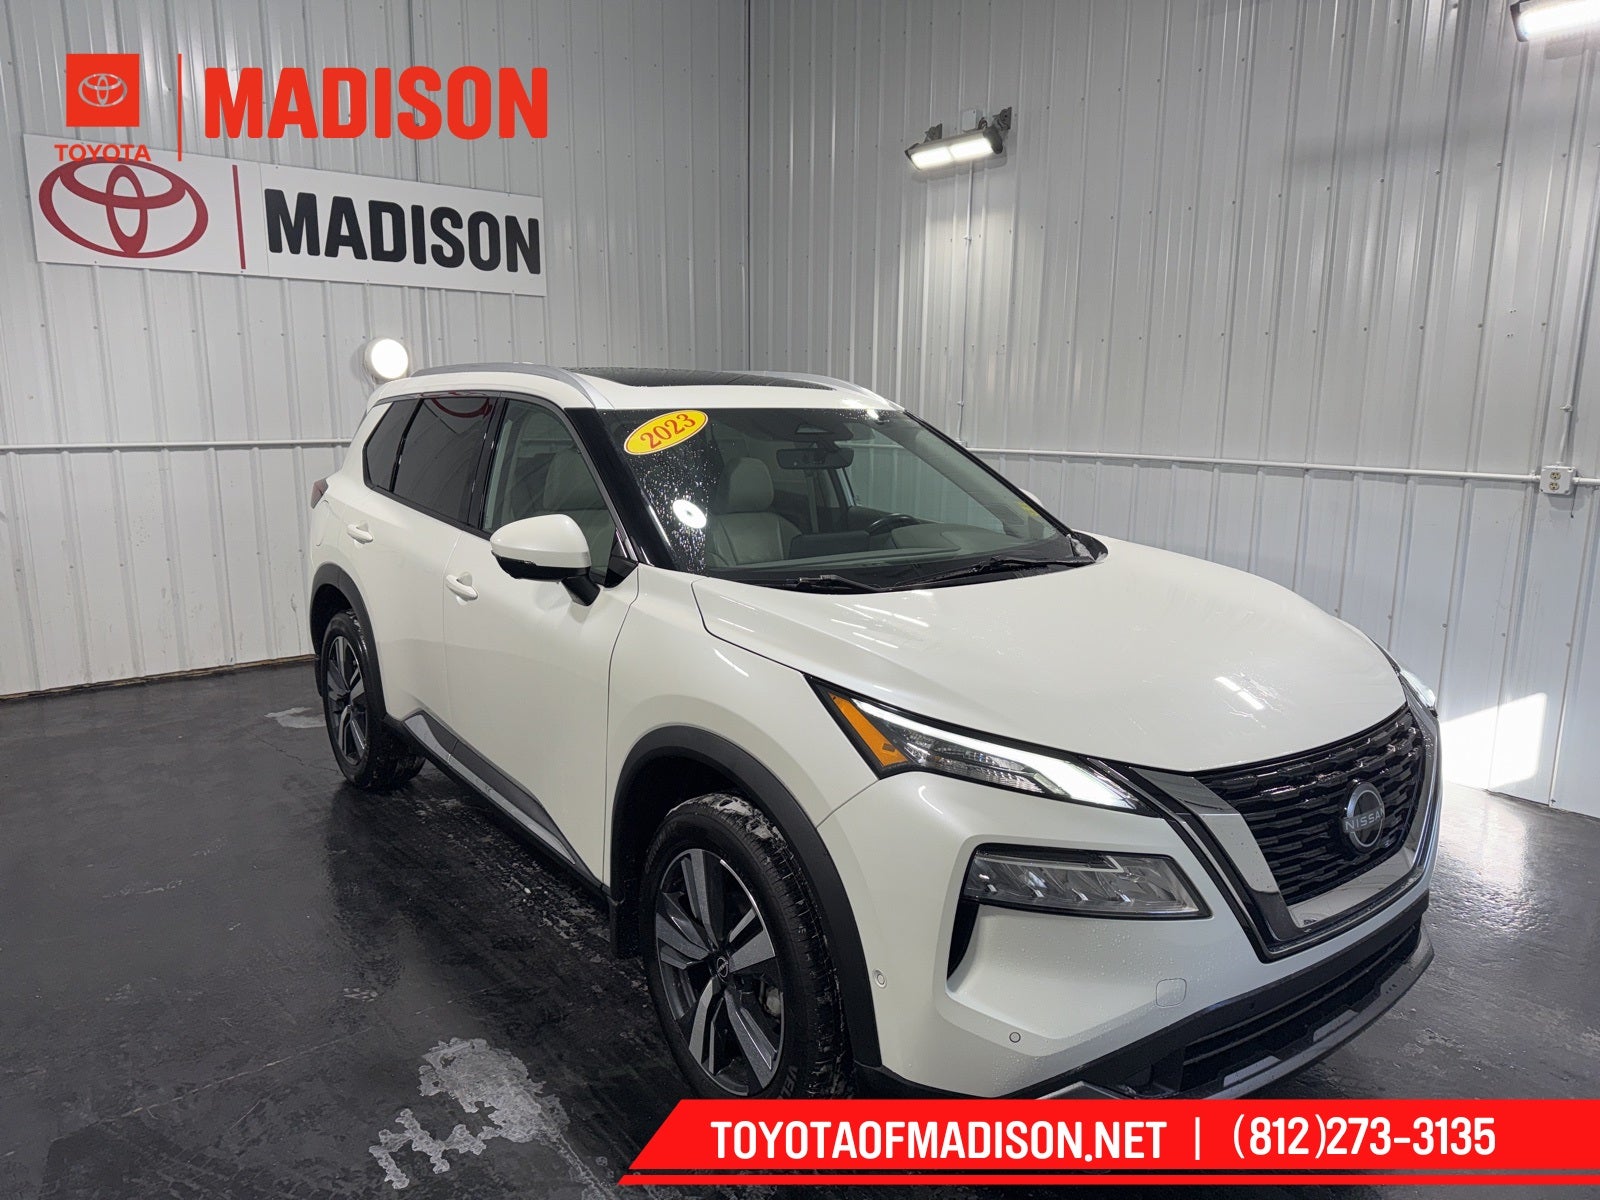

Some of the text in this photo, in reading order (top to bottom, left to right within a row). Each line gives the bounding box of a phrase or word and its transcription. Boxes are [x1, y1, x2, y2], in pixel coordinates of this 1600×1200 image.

[264, 188, 541, 275] MADISON
[640, 413, 696, 449] 2023
[1345, 807, 1384, 831] NISSAN
